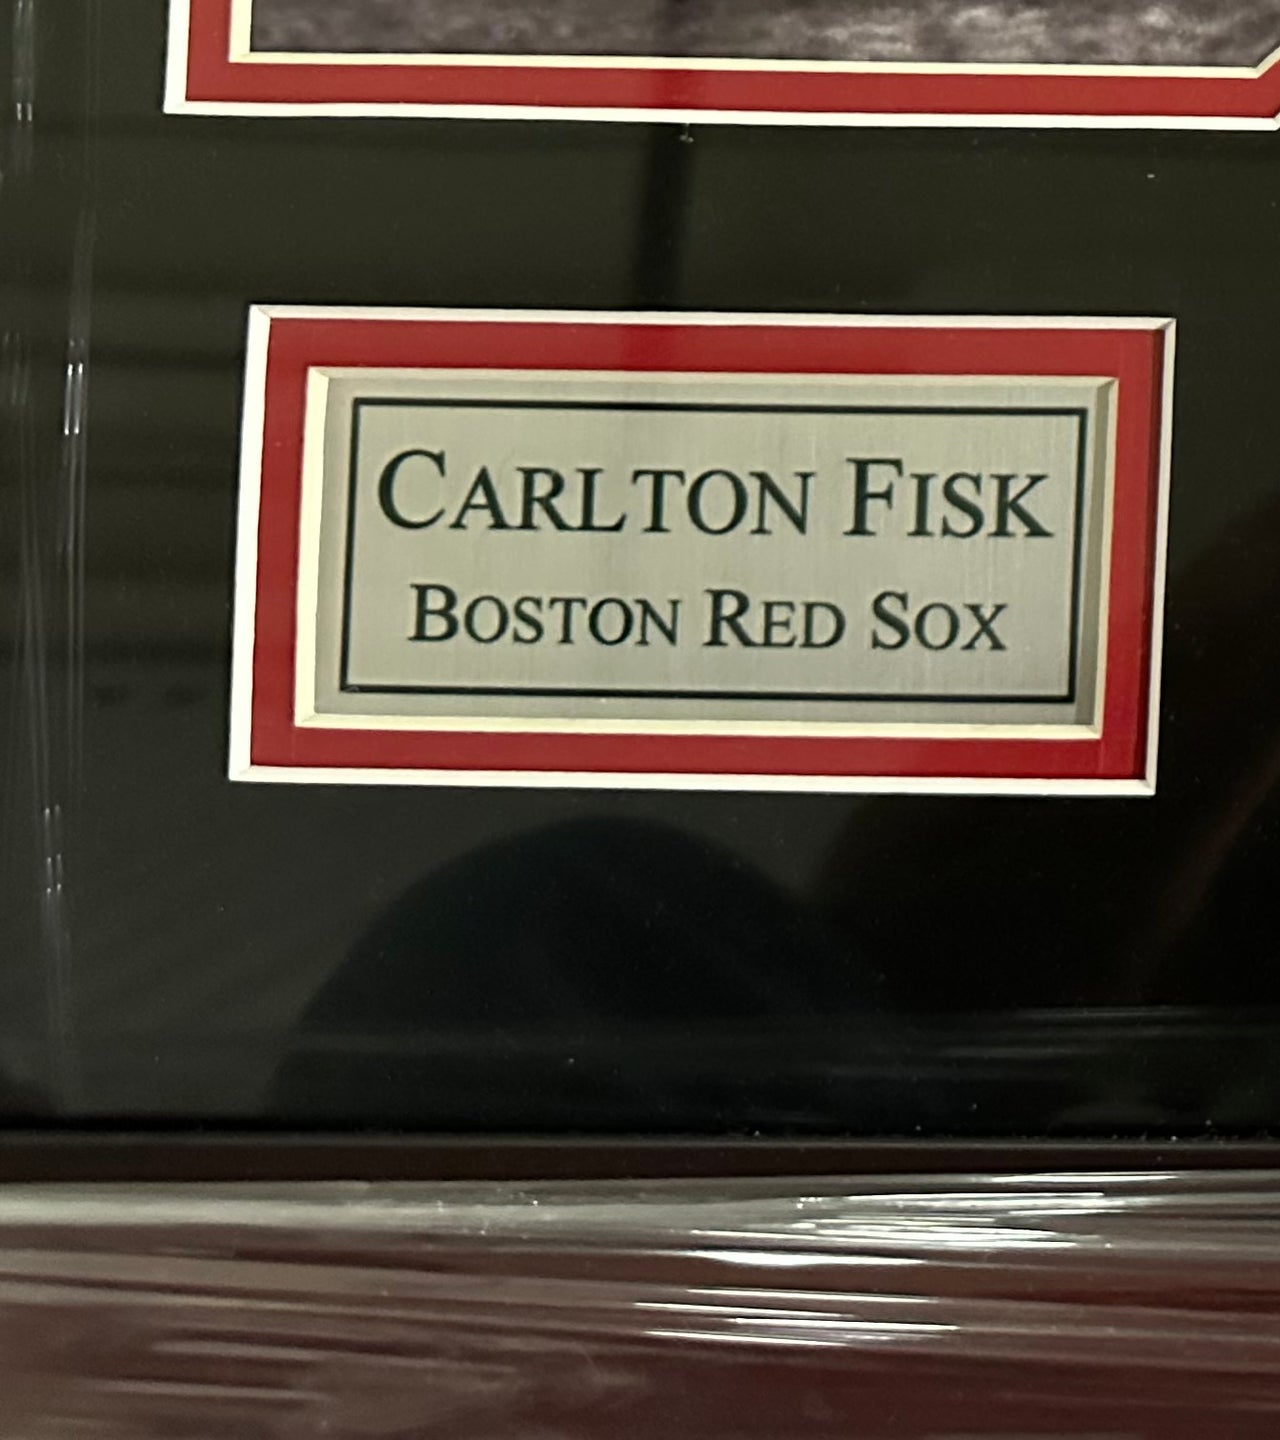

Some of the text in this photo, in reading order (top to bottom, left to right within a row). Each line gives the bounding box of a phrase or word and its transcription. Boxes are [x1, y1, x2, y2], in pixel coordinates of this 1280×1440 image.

[376, 448, 1055, 541] CARLTON FISK
[407, 582, 1009, 653] BOSTON RED SOX
